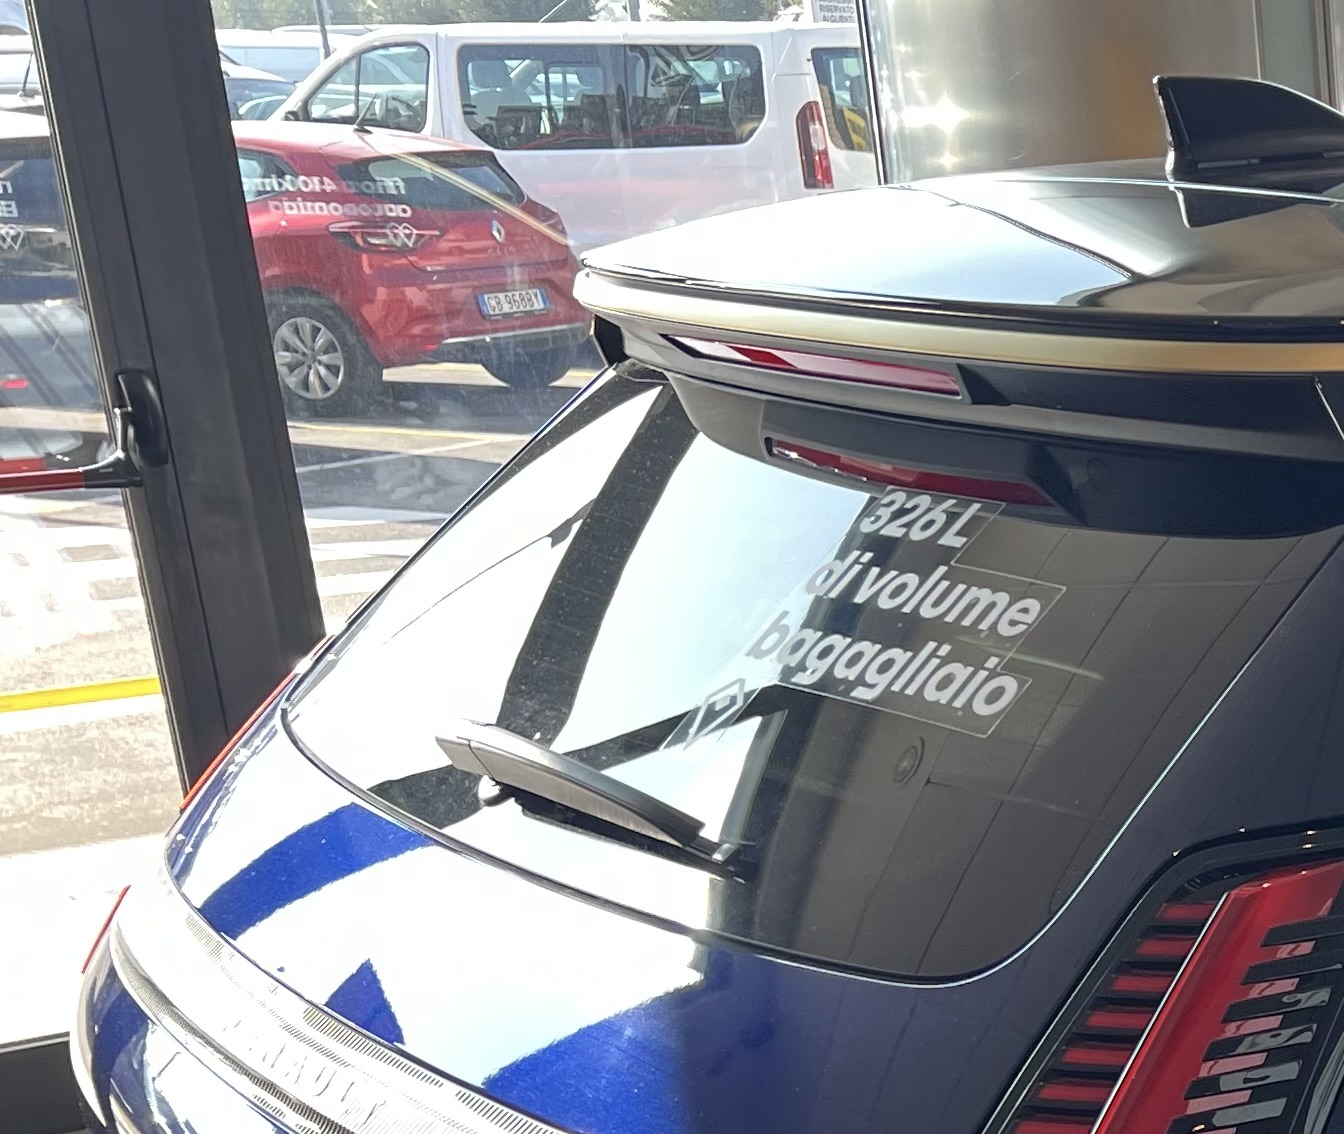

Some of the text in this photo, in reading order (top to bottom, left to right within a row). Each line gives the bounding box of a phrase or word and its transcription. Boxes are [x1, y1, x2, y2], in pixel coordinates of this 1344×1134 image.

[806, 551, 1043, 638] di volume
[746, 610, 1018, 716] bagagliaio
